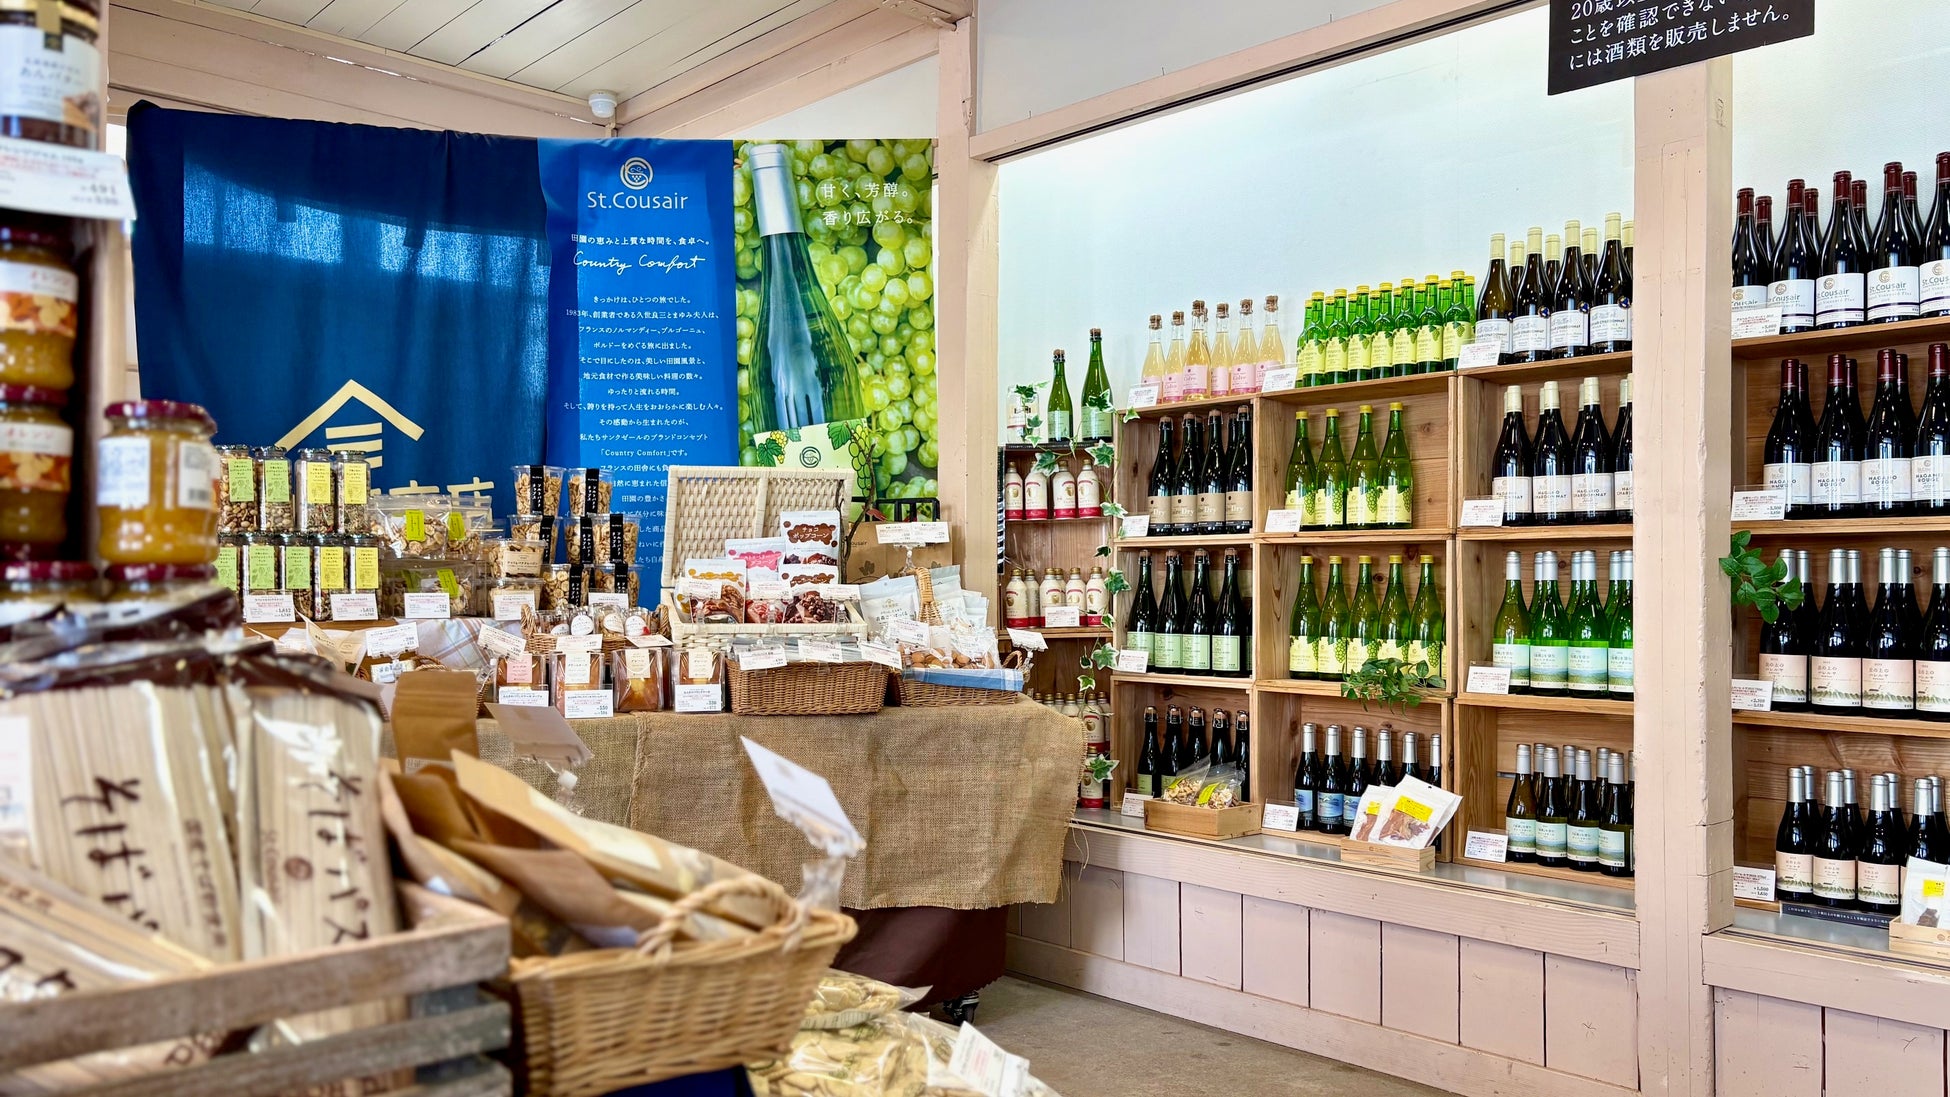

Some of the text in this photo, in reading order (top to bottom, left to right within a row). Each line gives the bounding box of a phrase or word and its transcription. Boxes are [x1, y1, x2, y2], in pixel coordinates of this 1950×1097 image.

[1569, 5, 1790, 71] には酒類を販売しません。
[820, 182, 909, 199] 甘く、芳醇。
[587, 191, 688, 210] St.Cousair
[822, 210, 914, 227] 香り広がる。
[571, 233, 710, 246] 田園の恵みと上質な時間を、食卓へ。
[573, 251, 706, 276] Country Comfort
[593, 295, 691, 304] きっかけは、ひとつの旅でした。
[566, 308, 719, 320] 1983年、創業者である久世良三とまゆみ夫人は、
[579, 326, 705, 335] フランスのノルマンディー、ブルゴーニュ、
[593, 341, 692, 350] ボルドーをめぐる旅に出ました。
[580, 356, 706, 365] そこで目にしたのは、美しい田園風景と、
[582, 372, 703, 381] 地元食材で作る美味しい料理の数々。
[607, 387, 680, 396] ゆったりと流れる時間。
[563, 402, 724, 412] そして、誇りを持って人生をおおらかに楽しむ人々。
[599, 418, 689, 427] その感動から生まれたのが、
[579, 433, 709, 442] 私たちサンクゼールのブランドコンセプト
[1181, 508, 1194, 517] Dry
[1204, 506, 1217, 514] Dry
[1231, 505, 1244, 513] Dry
[793, 532, 829, 540] ポップコーン
